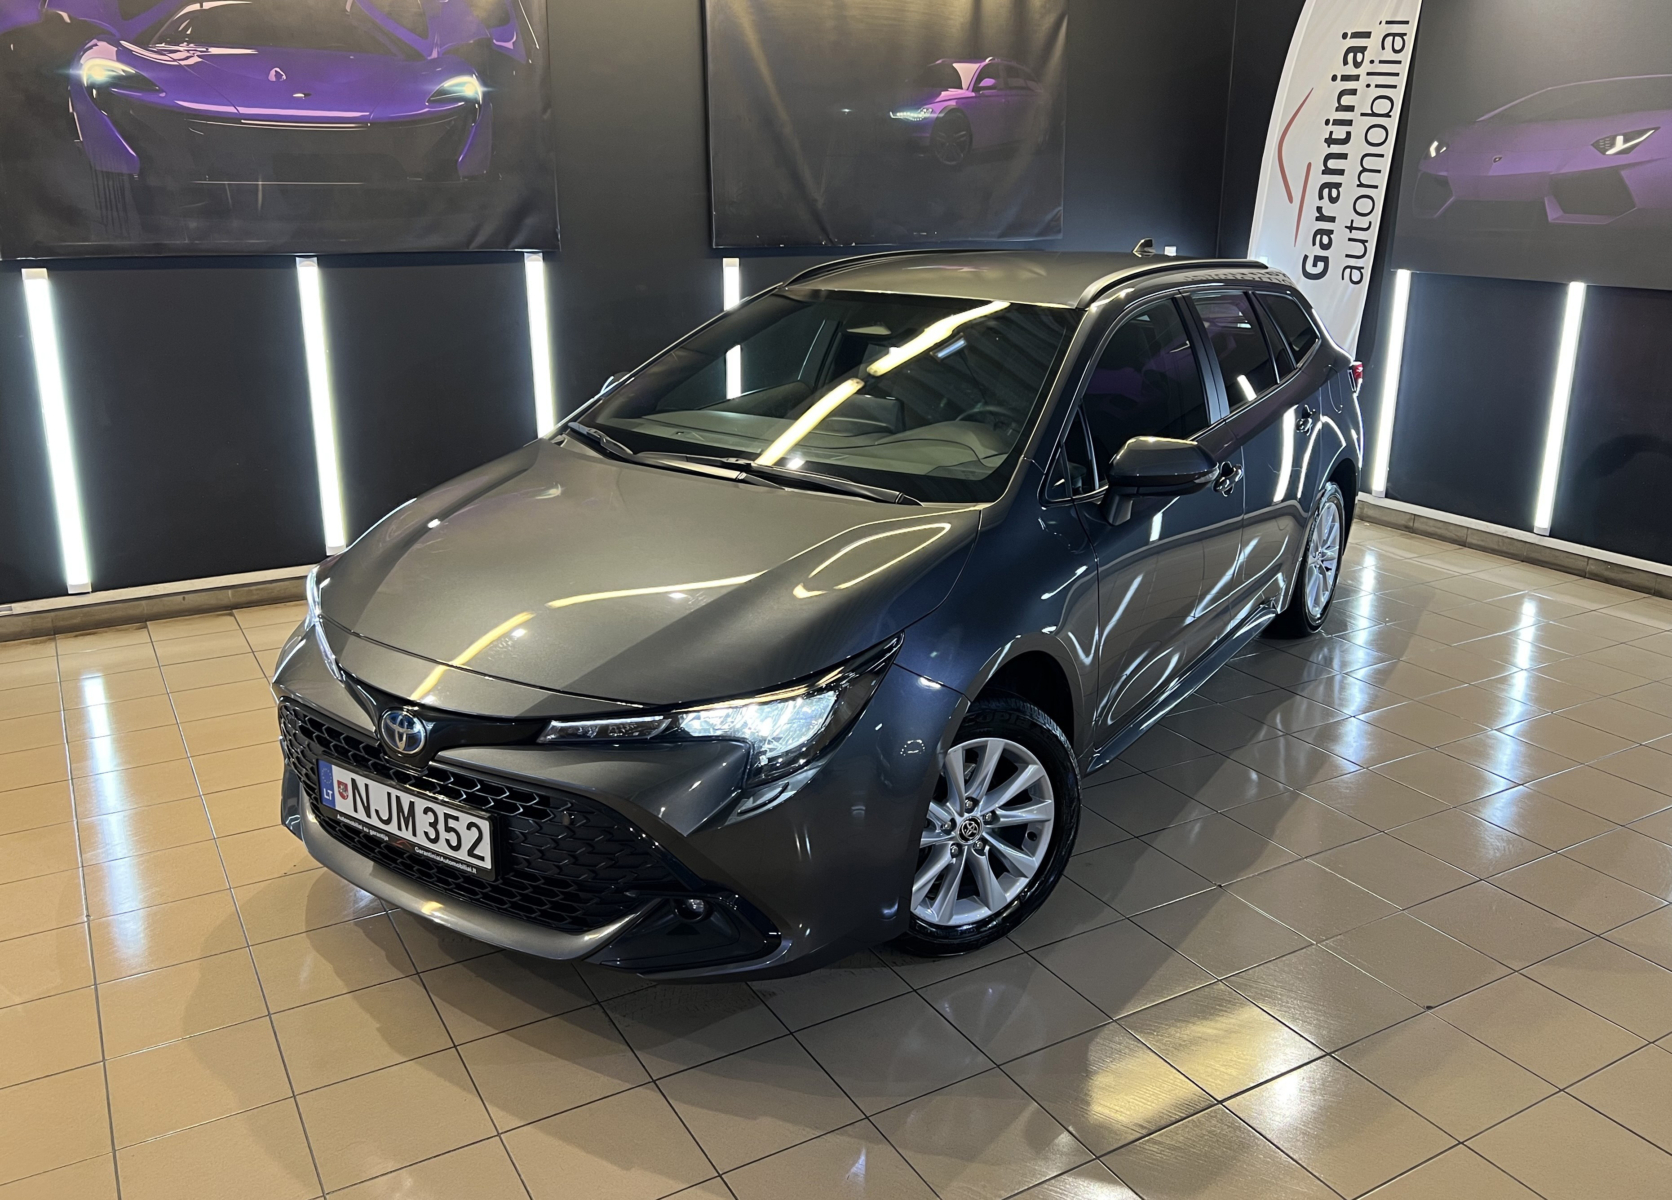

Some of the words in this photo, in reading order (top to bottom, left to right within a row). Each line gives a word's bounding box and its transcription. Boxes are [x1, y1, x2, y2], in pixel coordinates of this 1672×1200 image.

[1301, 30, 1372, 281] Garantiniai
[1341, 19, 1410, 286] automobiliai
[323, 788, 333, 801] LT
[350, 777, 485, 862] NJM352
